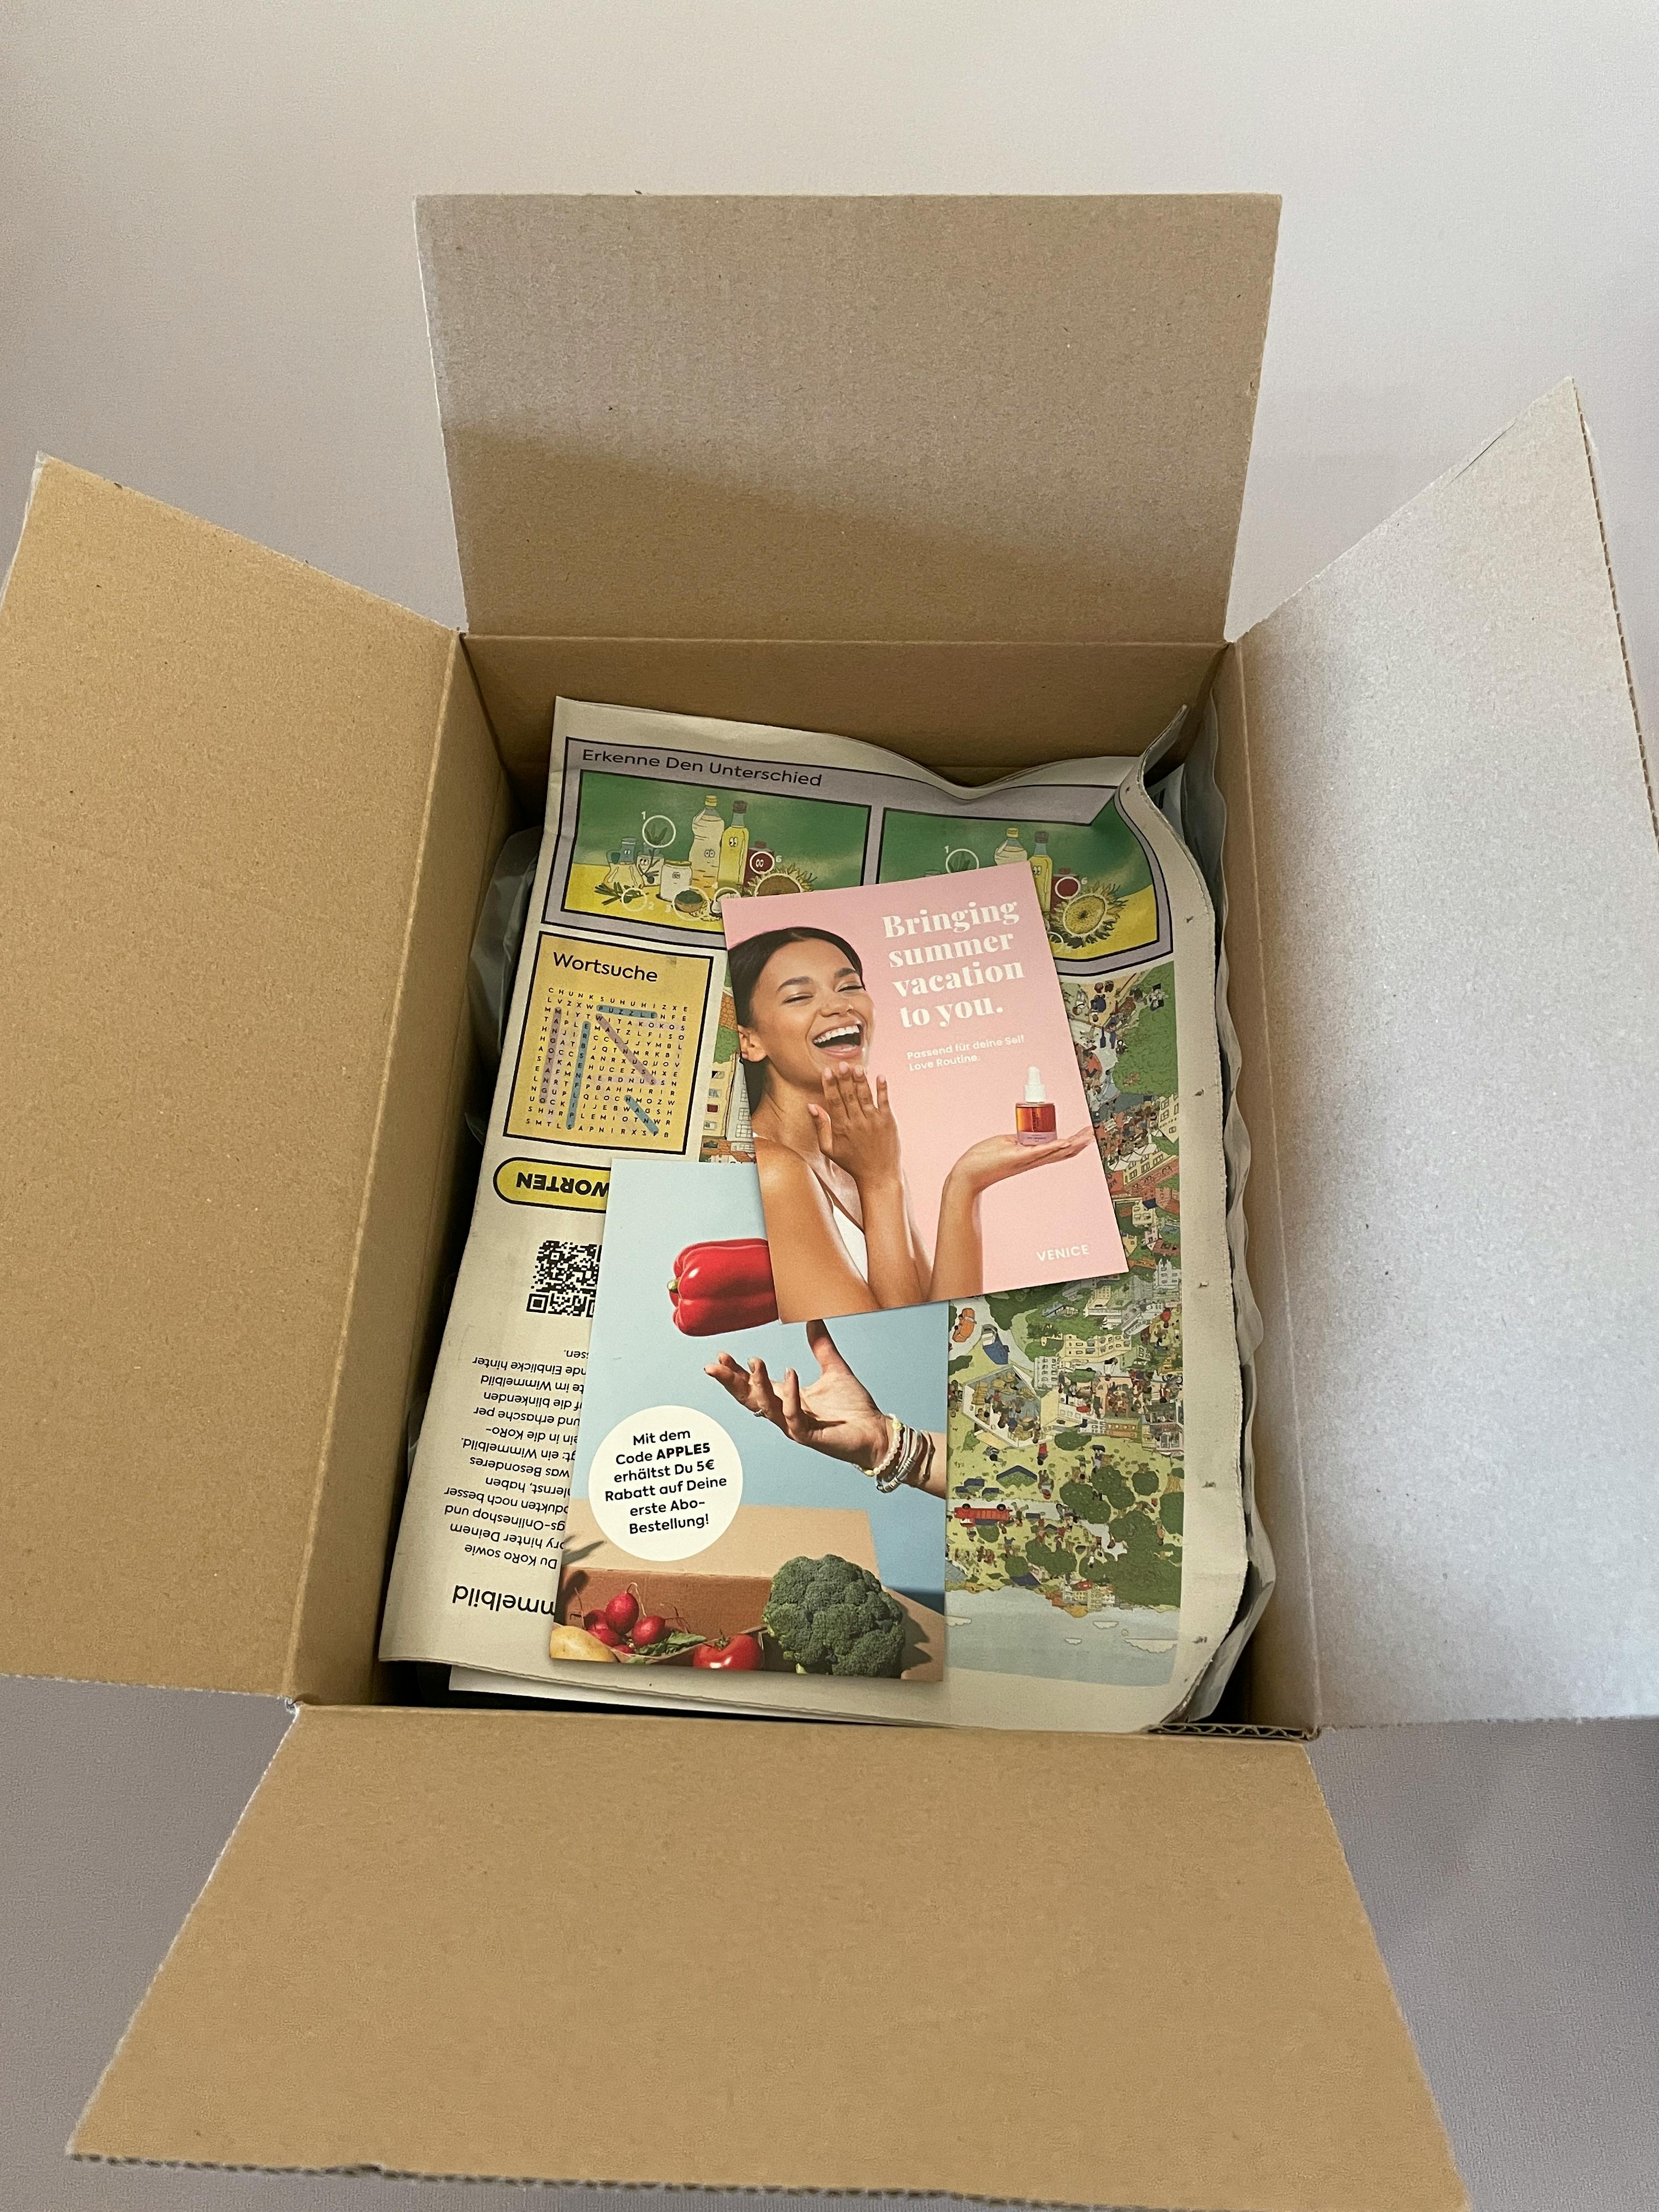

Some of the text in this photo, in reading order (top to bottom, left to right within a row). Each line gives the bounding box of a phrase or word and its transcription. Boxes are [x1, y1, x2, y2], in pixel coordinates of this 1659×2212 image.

[582, 749, 822, 787] Erkenne Den Unterschied
[641, 811, 646, 820] 1
[880, 901, 1021, 938] Bringing
[888, 933, 1014, 968] summer
[553, 951, 658, 982] Wortsuche
[891, 961, 1026, 997] vacation
[899, 997, 1004, 1028] to you.
[906, 1045, 953, 1060] Passend
[955, 1043, 971, 1052] für
[972, 1039, 1003, 1050] deine
[909, 1062, 934, 1071] Love
[1036, 1245, 1090, 1262] VENICE
[472, 1357, 586, 1377] nde Einblicke hinter
[481, 1375, 552, 1391] Wimmelbild
[555, 1382, 570, 1393] im
[483, 1392, 582, 1411] f die blinkenden
[473, 1407, 580, 1426] und erhasche per
[486, 1427, 524, 1439] KoRo-
[527, 1431, 545, 1443] die
[549, 1433, 559, 1443] in
[633, 1430, 691, 1446] Mit dem
[461, 1437, 536, 1459] Wimmelbild.
[541, 1450, 559, 1460] ein
[615, 1442, 711, 1465] Code APPLE5
[469, 1457, 570, 1478] was Besonderes
[614, 1459, 715, 1483] erhältst Du 5€
[443, 1487, 484, 1504] besser
[486, 1477, 570, 1498] lernst, haben
[604, 1477, 727, 1502] Rabatt auf Deine
[487, 1495, 518, 1506] noch
[630, 1499, 706, 1516] erste Abo-
[444, 1505, 565, 1531] gs-Onlineshop und
[629, 1513, 709, 1535] Bestellung!
[450, 1524, 500, 1542] Deinem
[503, 1533, 542, 1549] hinter
[465, 1545, 557, 1569] Du KoRo sowie
